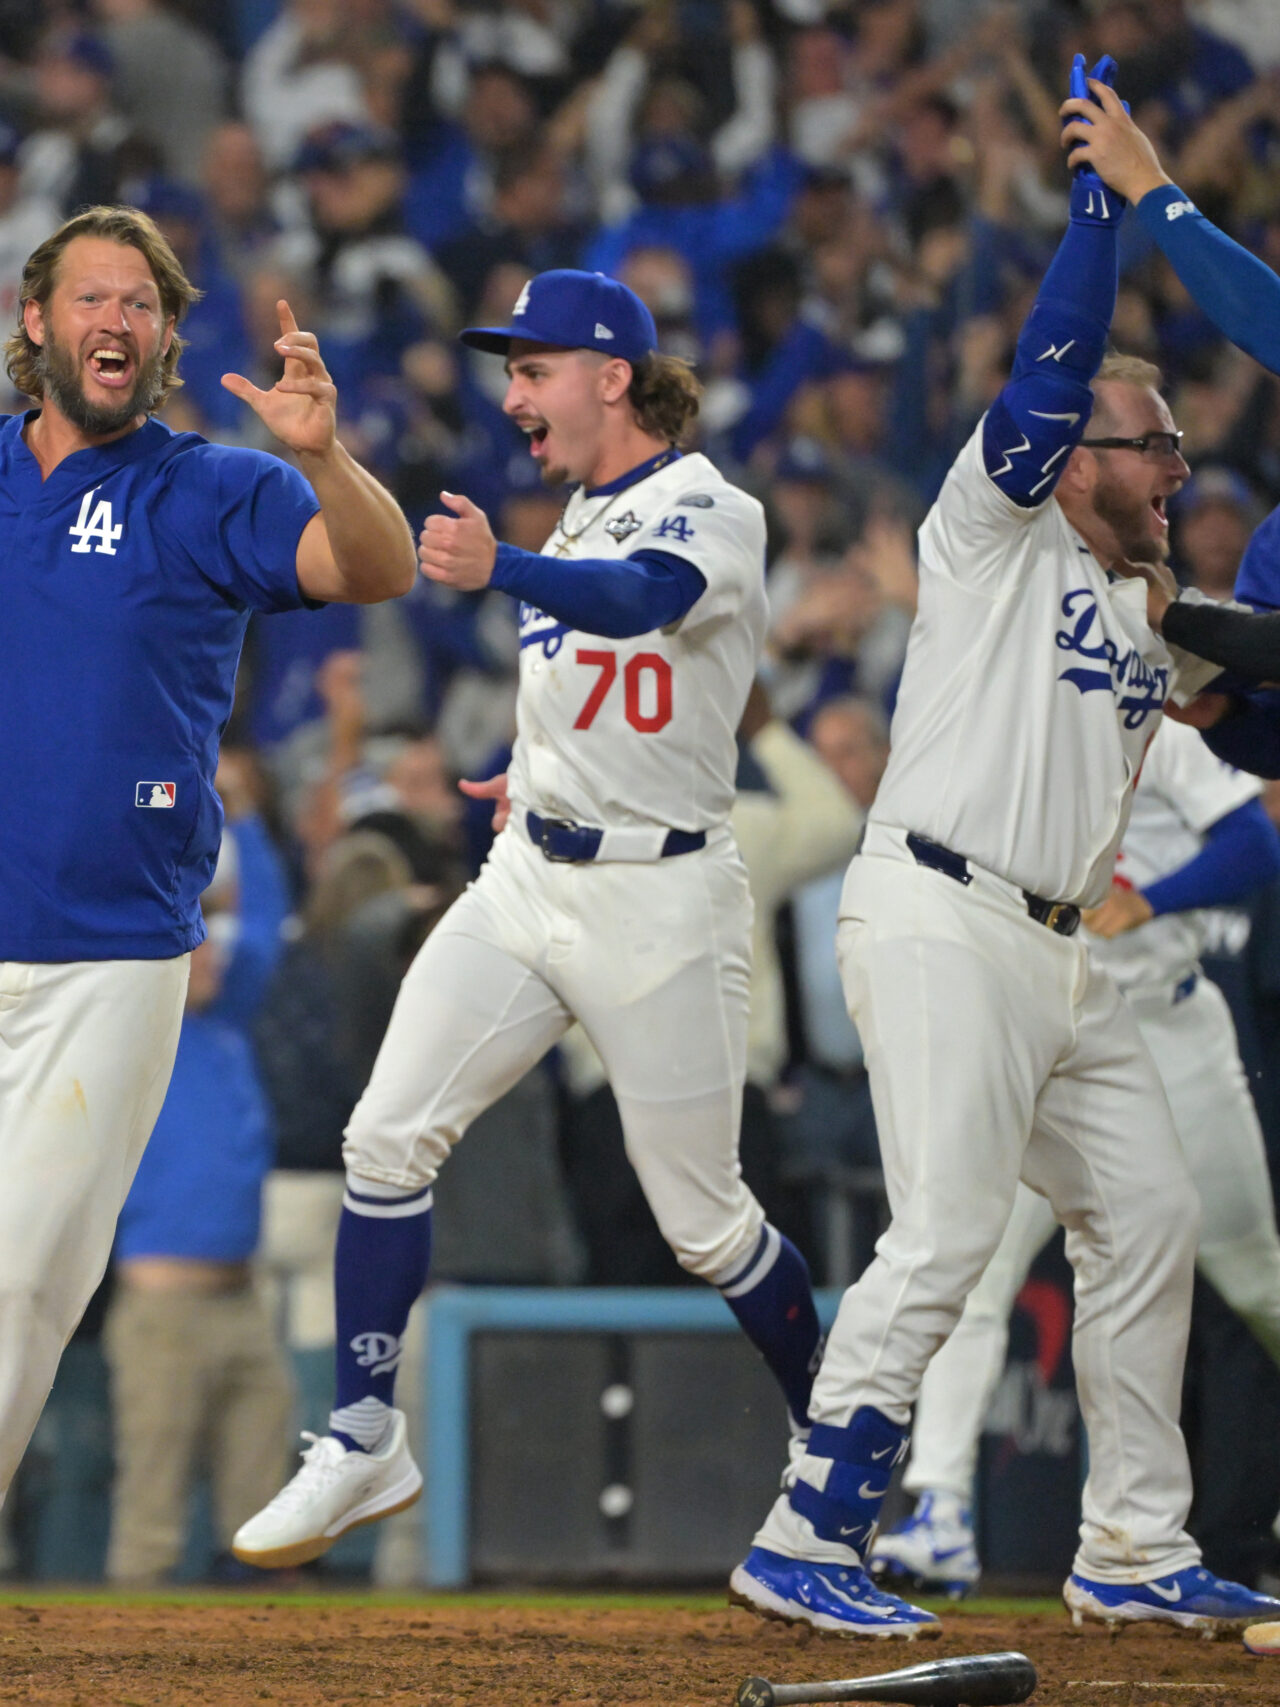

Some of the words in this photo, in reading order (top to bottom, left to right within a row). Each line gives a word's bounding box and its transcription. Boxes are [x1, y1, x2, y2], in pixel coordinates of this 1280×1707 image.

[69, 484, 123, 556] LA
[652, 515, 695, 543] LA
[573, 648, 673, 733] 70
